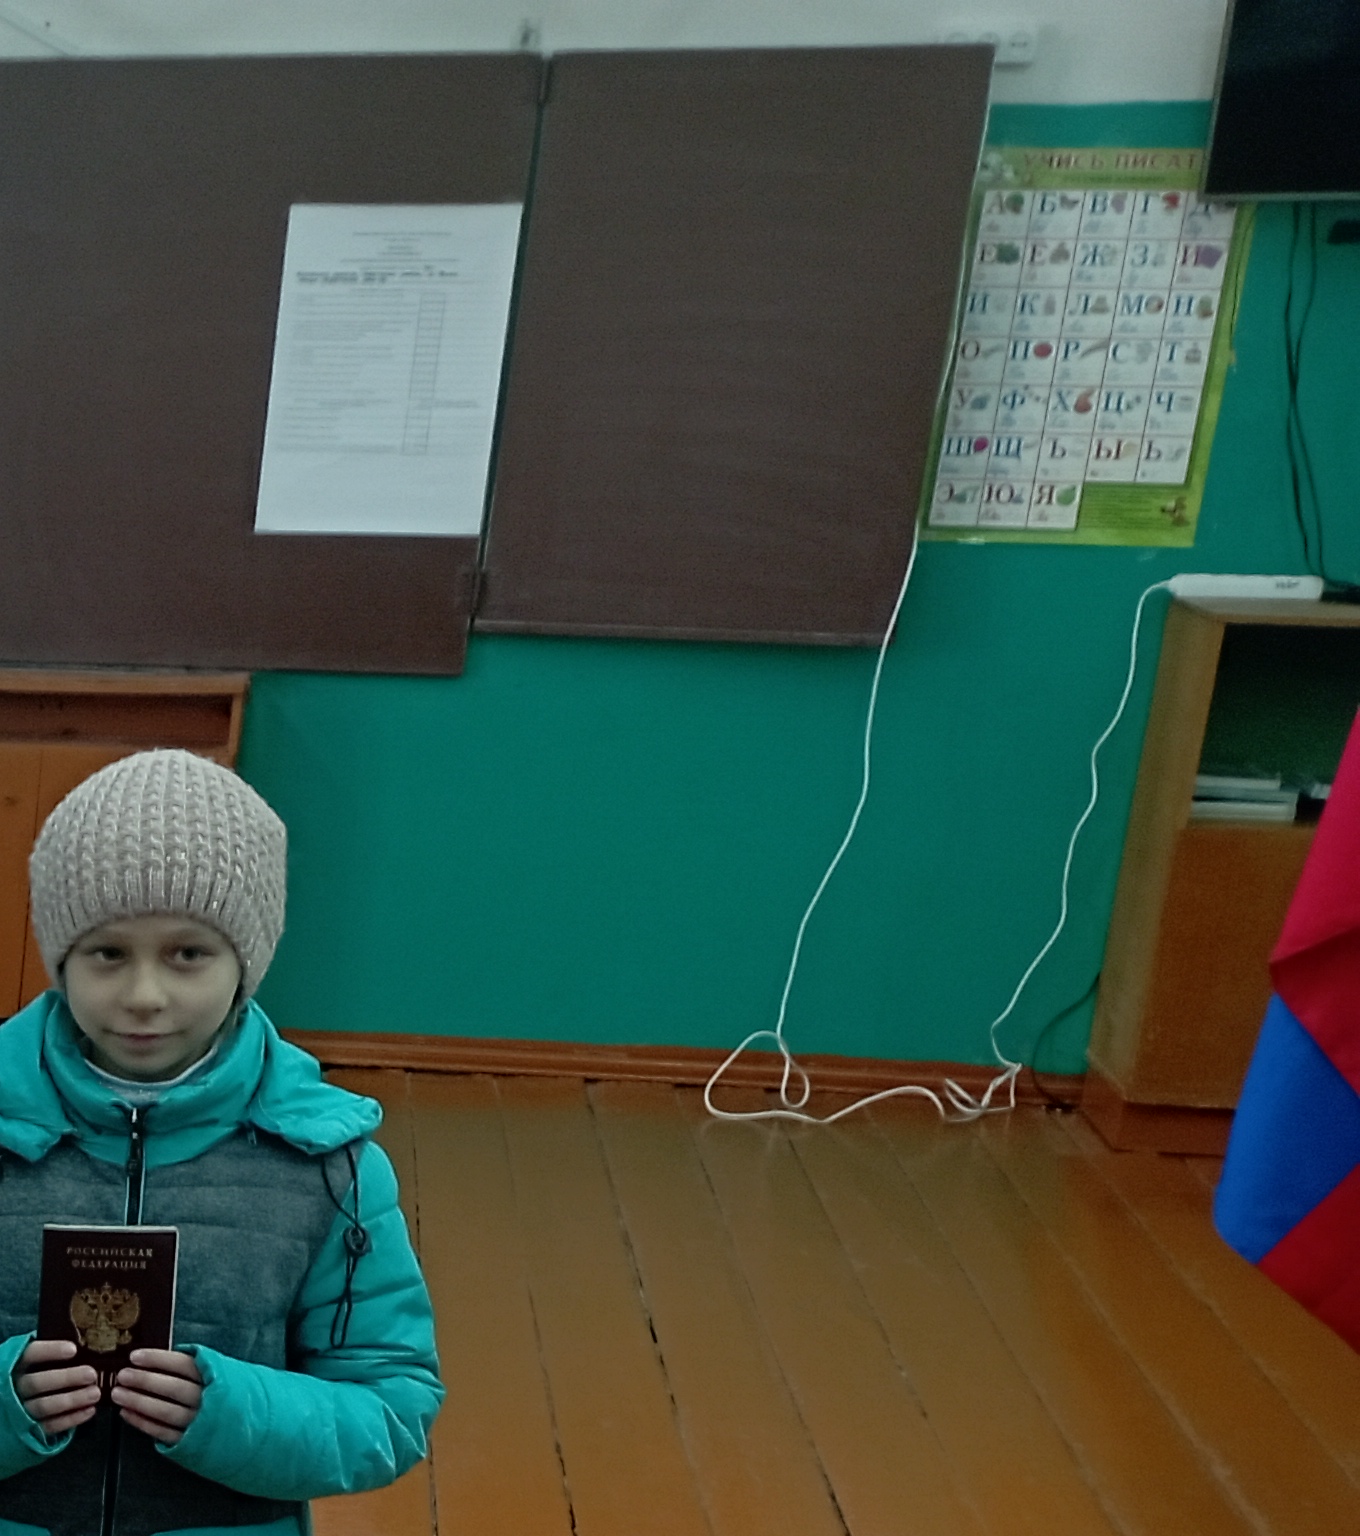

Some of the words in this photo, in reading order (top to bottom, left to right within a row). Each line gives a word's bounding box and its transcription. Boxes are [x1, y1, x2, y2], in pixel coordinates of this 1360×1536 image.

[1024, 152, 1104, 171] УЧИСЬ
[1115, 153, 1197, 172] ПИСАТ
[987, 191, 1006, 214] А
[1039, 192, 1057, 215] Б
[1089, 192, 1108, 215] В
[1140, 192, 1159, 214] Г
[980, 242, 996, 265] Е
[1081, 242, 1107, 266] Ж
[1131, 243, 1149, 266] З
[1019, 294, 1040, 315] К
[1067, 294, 1091, 316] Л
[1120, 294, 1146, 316] М
[1173, 295, 1195, 317] Н
[960, 340, 980, 359] О
[1010, 341, 1031, 361] П
[1061, 341, 1080, 361] Р
[1111, 341, 1130, 363] С
[1161, 342, 1179, 363] Т
[955, 388, 974, 410] У
[1002, 389, 1025, 410] Ф
[1053, 390, 1073, 412] Х
[1103, 391, 1124, 415] Ц
[1154, 391, 1175, 413] Ч
[945, 436, 973, 456] Ш
[993, 436, 1023, 460] Щ
[1094, 439, 1123, 460] Ы
[937, 483, 954, 504] Э
[985, 483, 1016, 505] Ю
[1035, 484, 1056, 505] Я
[66, 1246, 153, 1257] РОССИЙСКАЯ
[71, 1259, 147, 1271] ФЕДЕРАЦИЯ
